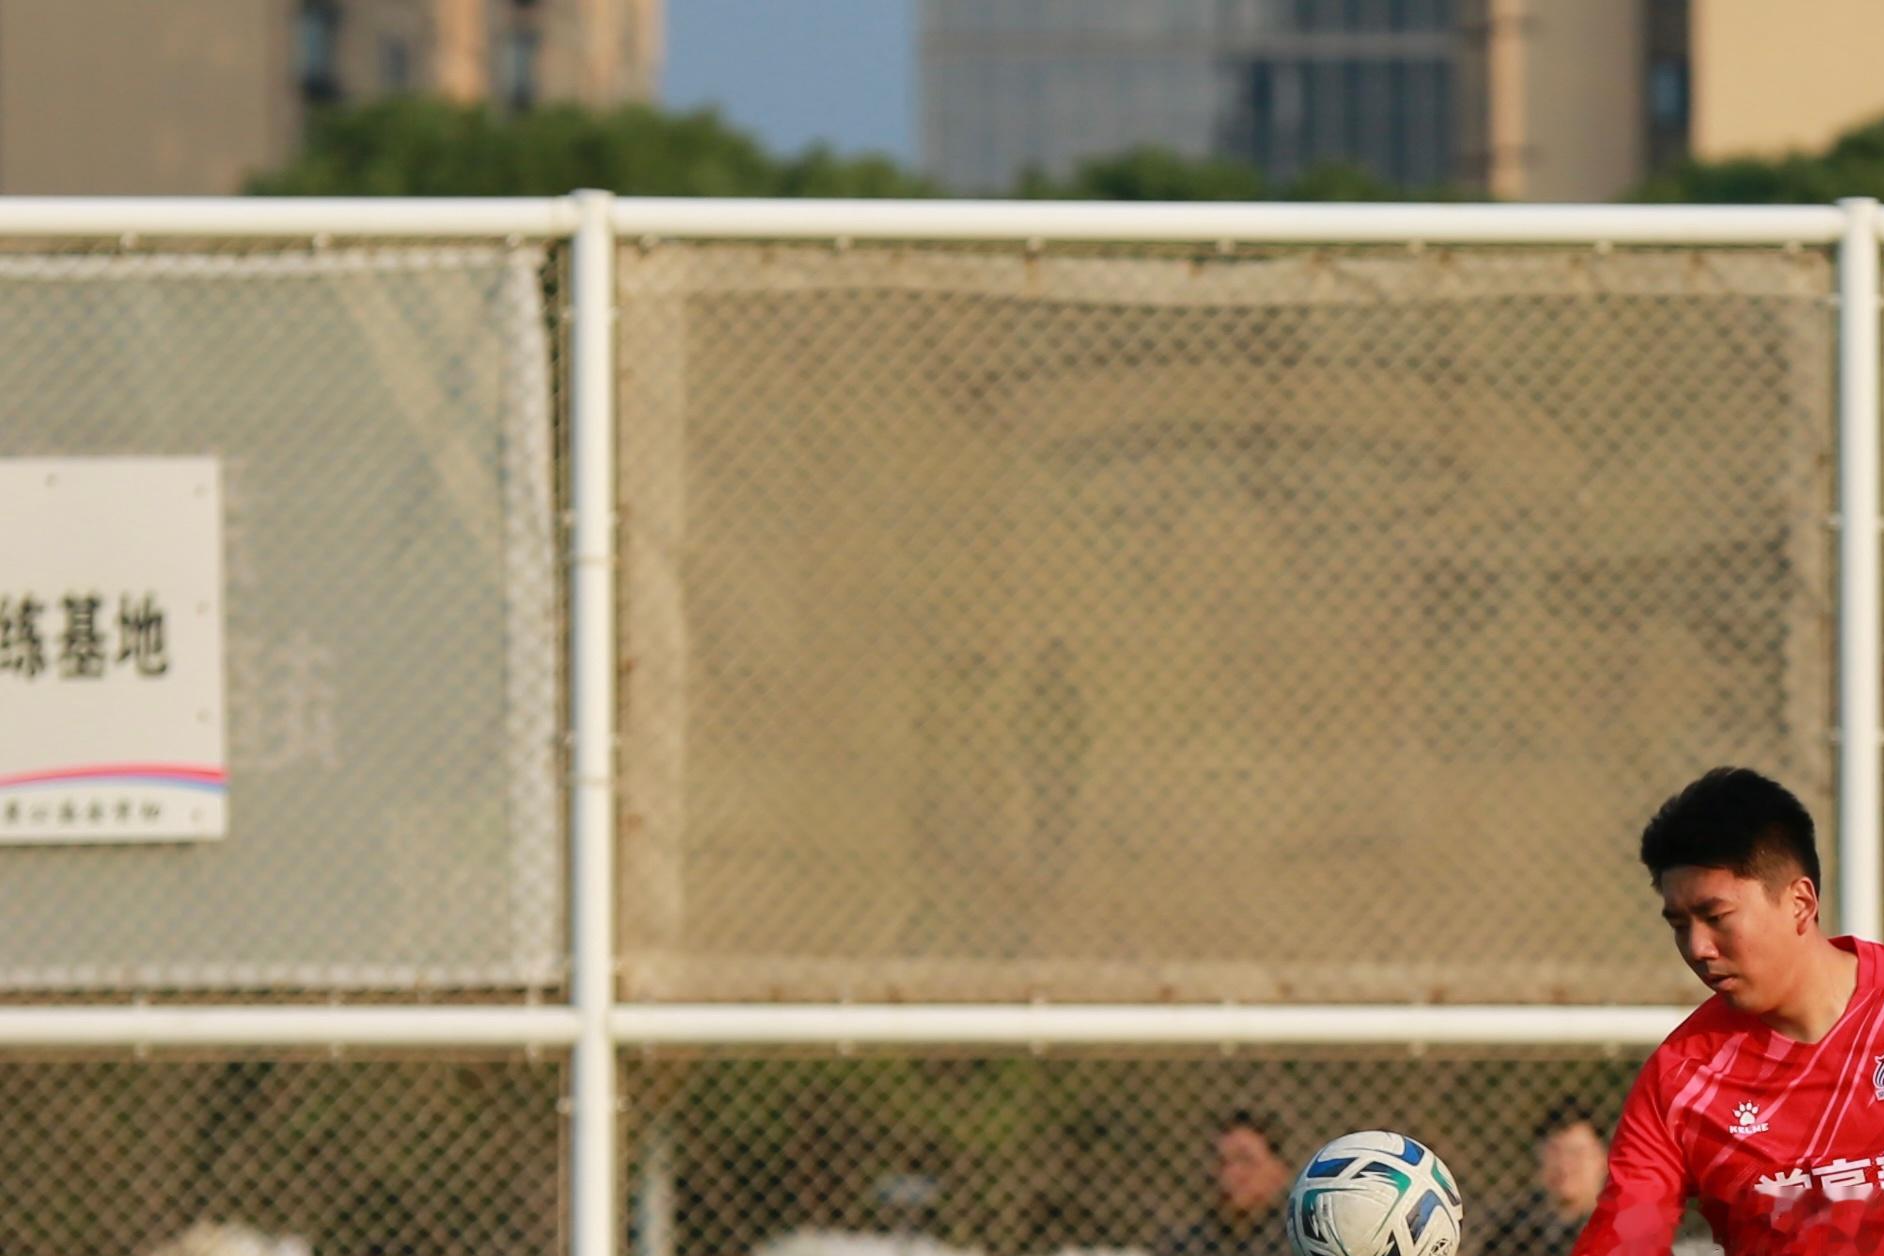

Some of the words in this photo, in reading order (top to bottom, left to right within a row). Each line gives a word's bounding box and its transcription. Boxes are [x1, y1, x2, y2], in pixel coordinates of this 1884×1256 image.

[0, 589, 168, 681] 练基地
[1729, 1122, 1769, 1134] KELME
